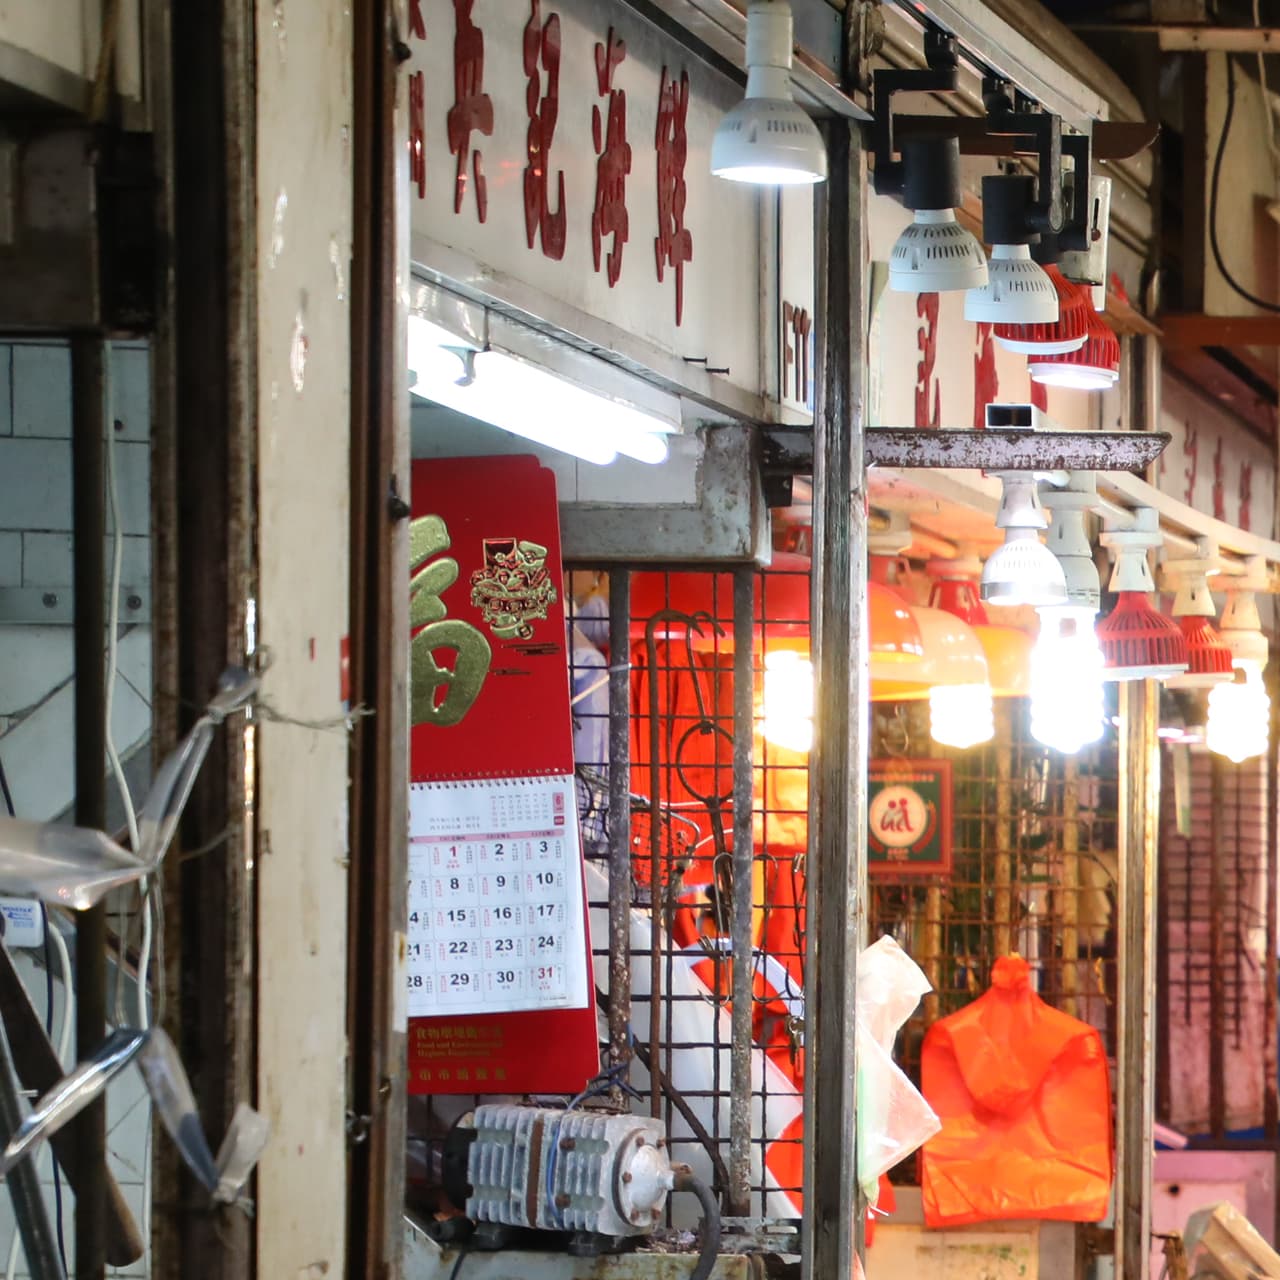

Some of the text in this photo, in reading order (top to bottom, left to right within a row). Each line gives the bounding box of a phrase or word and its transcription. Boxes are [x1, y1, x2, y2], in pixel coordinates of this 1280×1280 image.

[449, 840, 549, 857] 1 2 3
[449, 872, 554, 890] 8 9 10
[447, 909, 466, 922] 15
[493, 907, 512, 919] 16
[537, 904, 555, 917] 17
[449, 941, 468, 953] 22
[495, 939, 514, 951] 23
[538, 935, 555, 948] 24
[450, 973, 470, 986] 29
[496, 970, 515, 983] 30
[538, 966, 554, 979] 31
